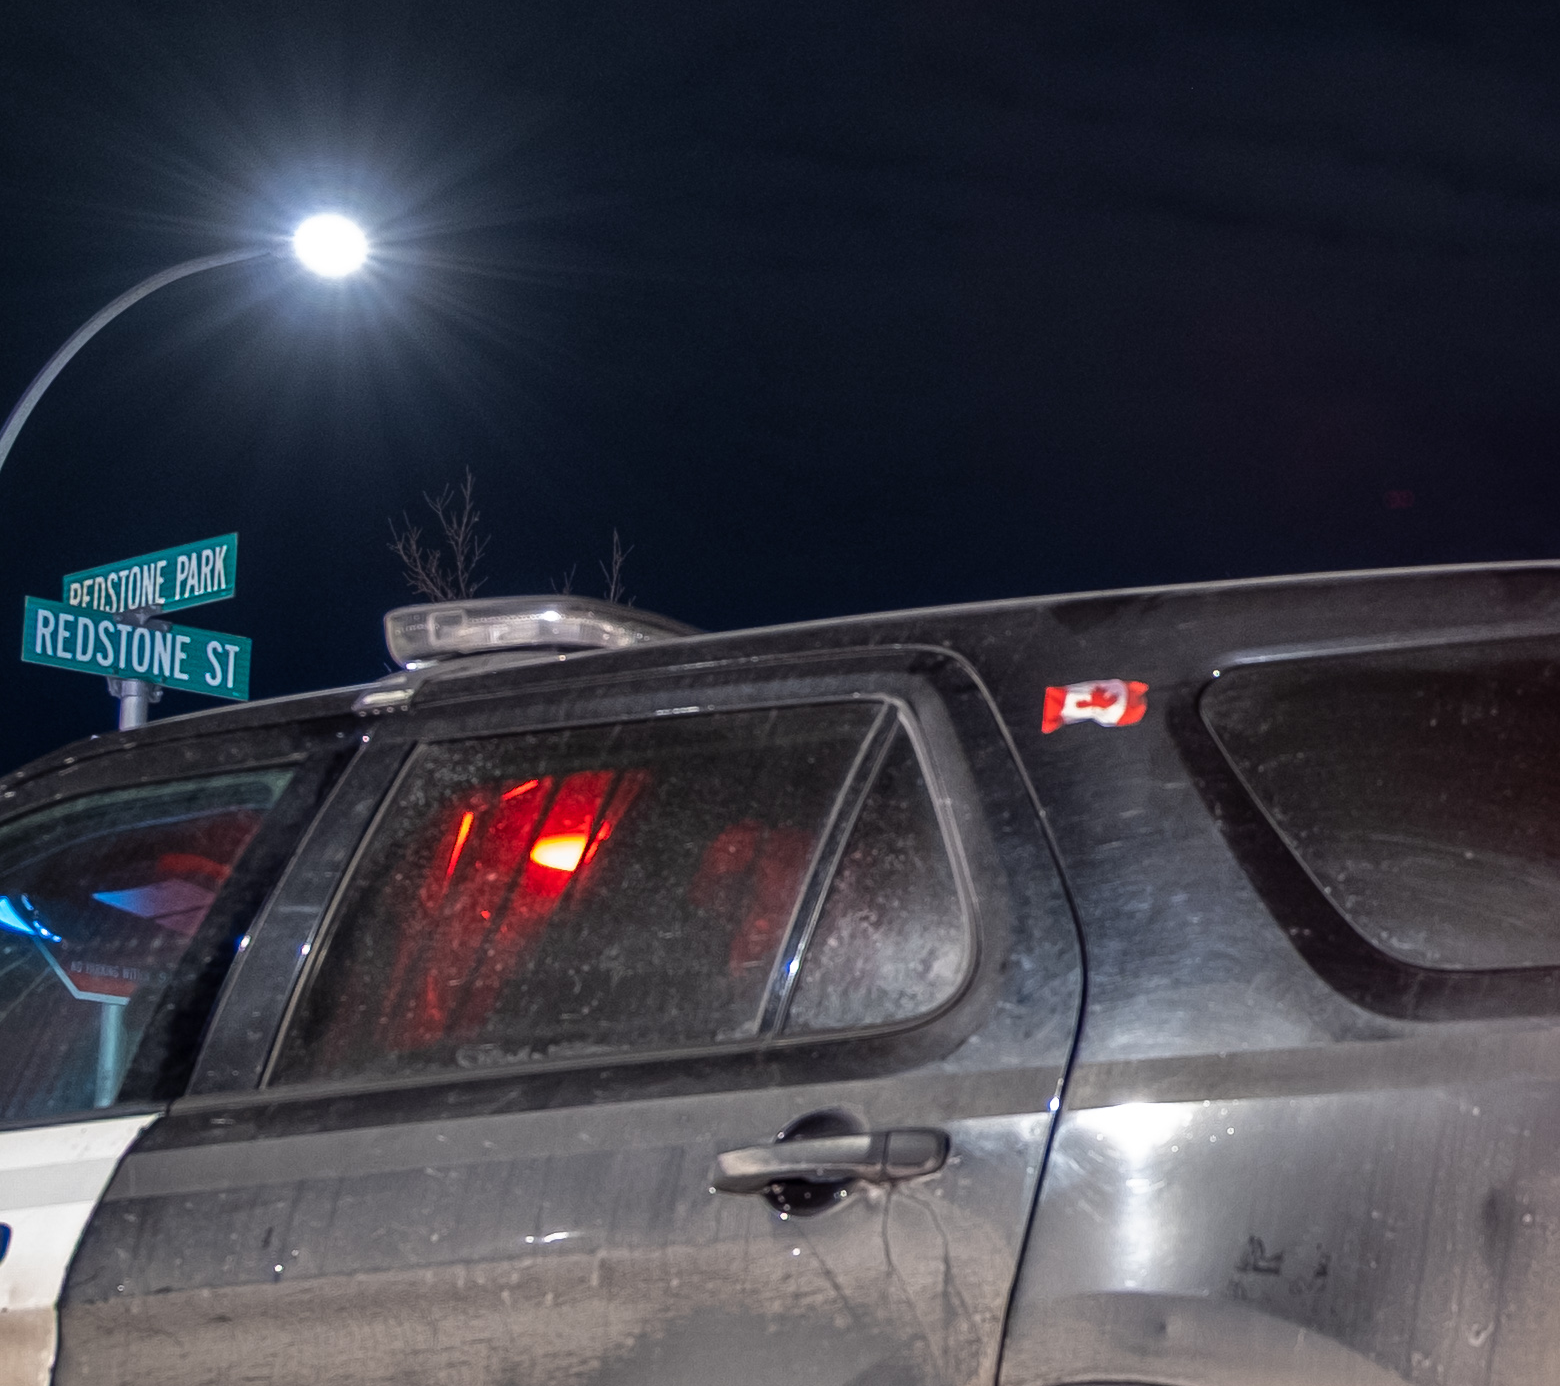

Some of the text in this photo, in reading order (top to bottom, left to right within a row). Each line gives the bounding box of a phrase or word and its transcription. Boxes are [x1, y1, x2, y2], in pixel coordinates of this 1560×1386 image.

[69, 544, 228, 613] REDSTONE PARK
[34, 608, 240, 689] REDSTONE ST
